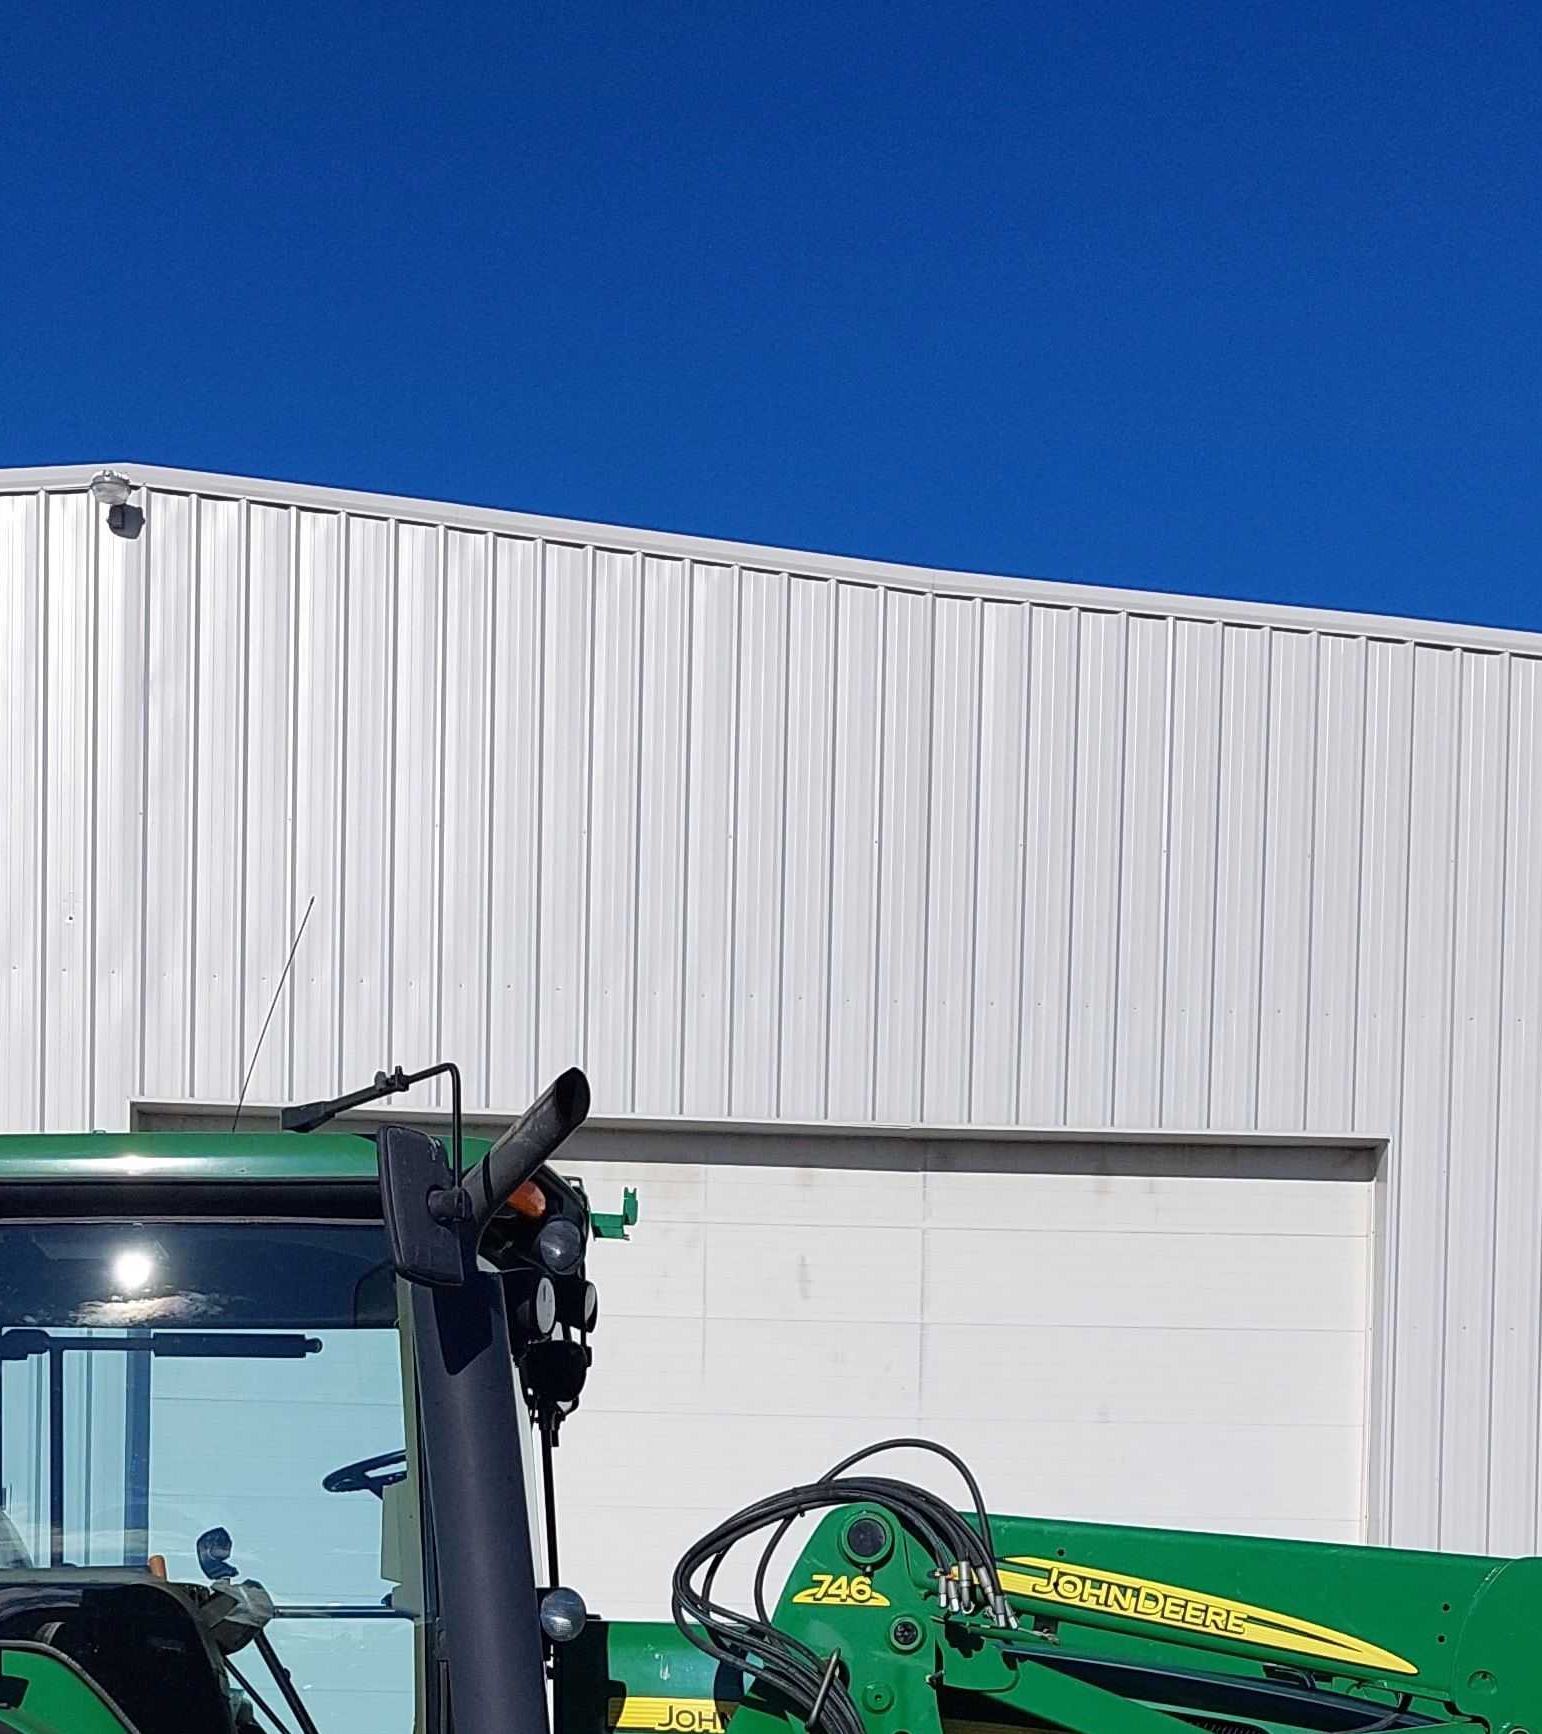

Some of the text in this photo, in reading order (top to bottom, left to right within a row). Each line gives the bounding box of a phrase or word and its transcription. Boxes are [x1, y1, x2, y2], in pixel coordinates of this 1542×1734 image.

[812, 1574, 873, 1603] 746
[1032, 1567, 1248, 1634] JOHN DEERE
